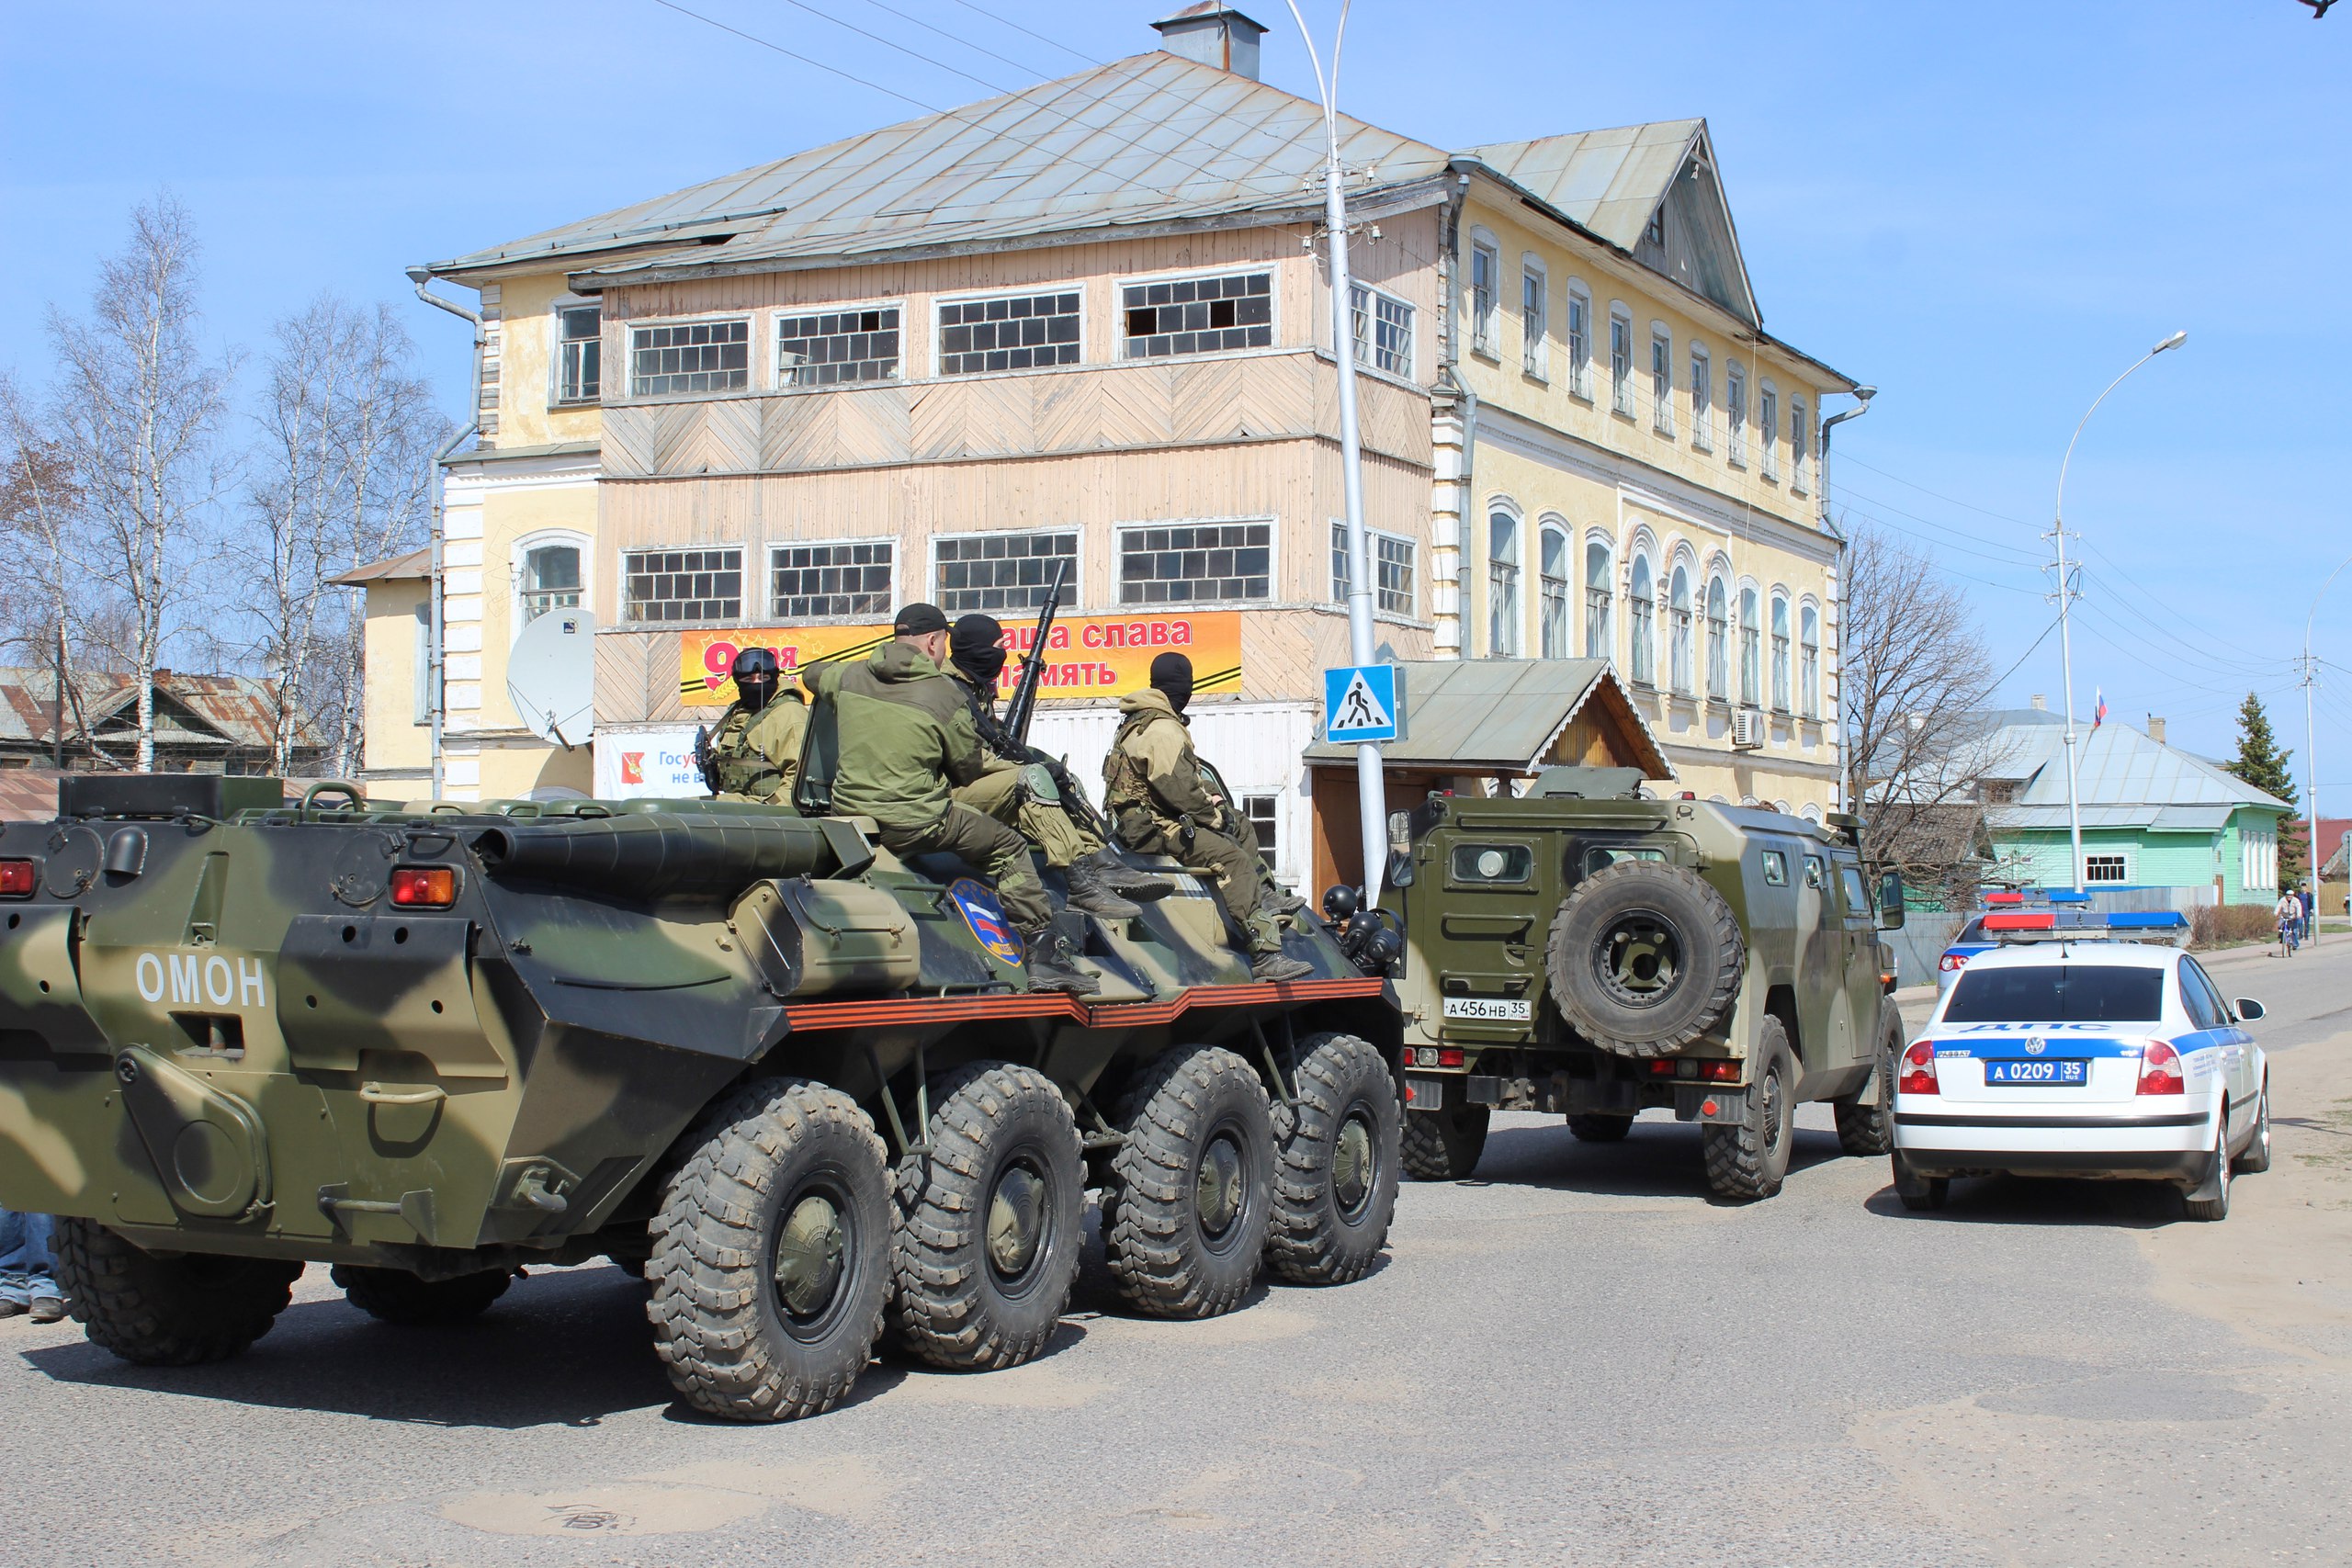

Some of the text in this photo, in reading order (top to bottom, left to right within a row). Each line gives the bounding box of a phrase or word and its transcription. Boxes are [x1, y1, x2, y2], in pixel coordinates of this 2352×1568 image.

[1082, 620, 1193, 649] слава
[703, 640, 740, 692] 9
[672, 773, 691, 784] не
[136, 952, 266, 1008] ОМОН
[1511, 1002, 1525, 1014] 35
[1958, 1022, 2112, 1033] ДПС
[2064, 1062, 2081, 1075] 35
